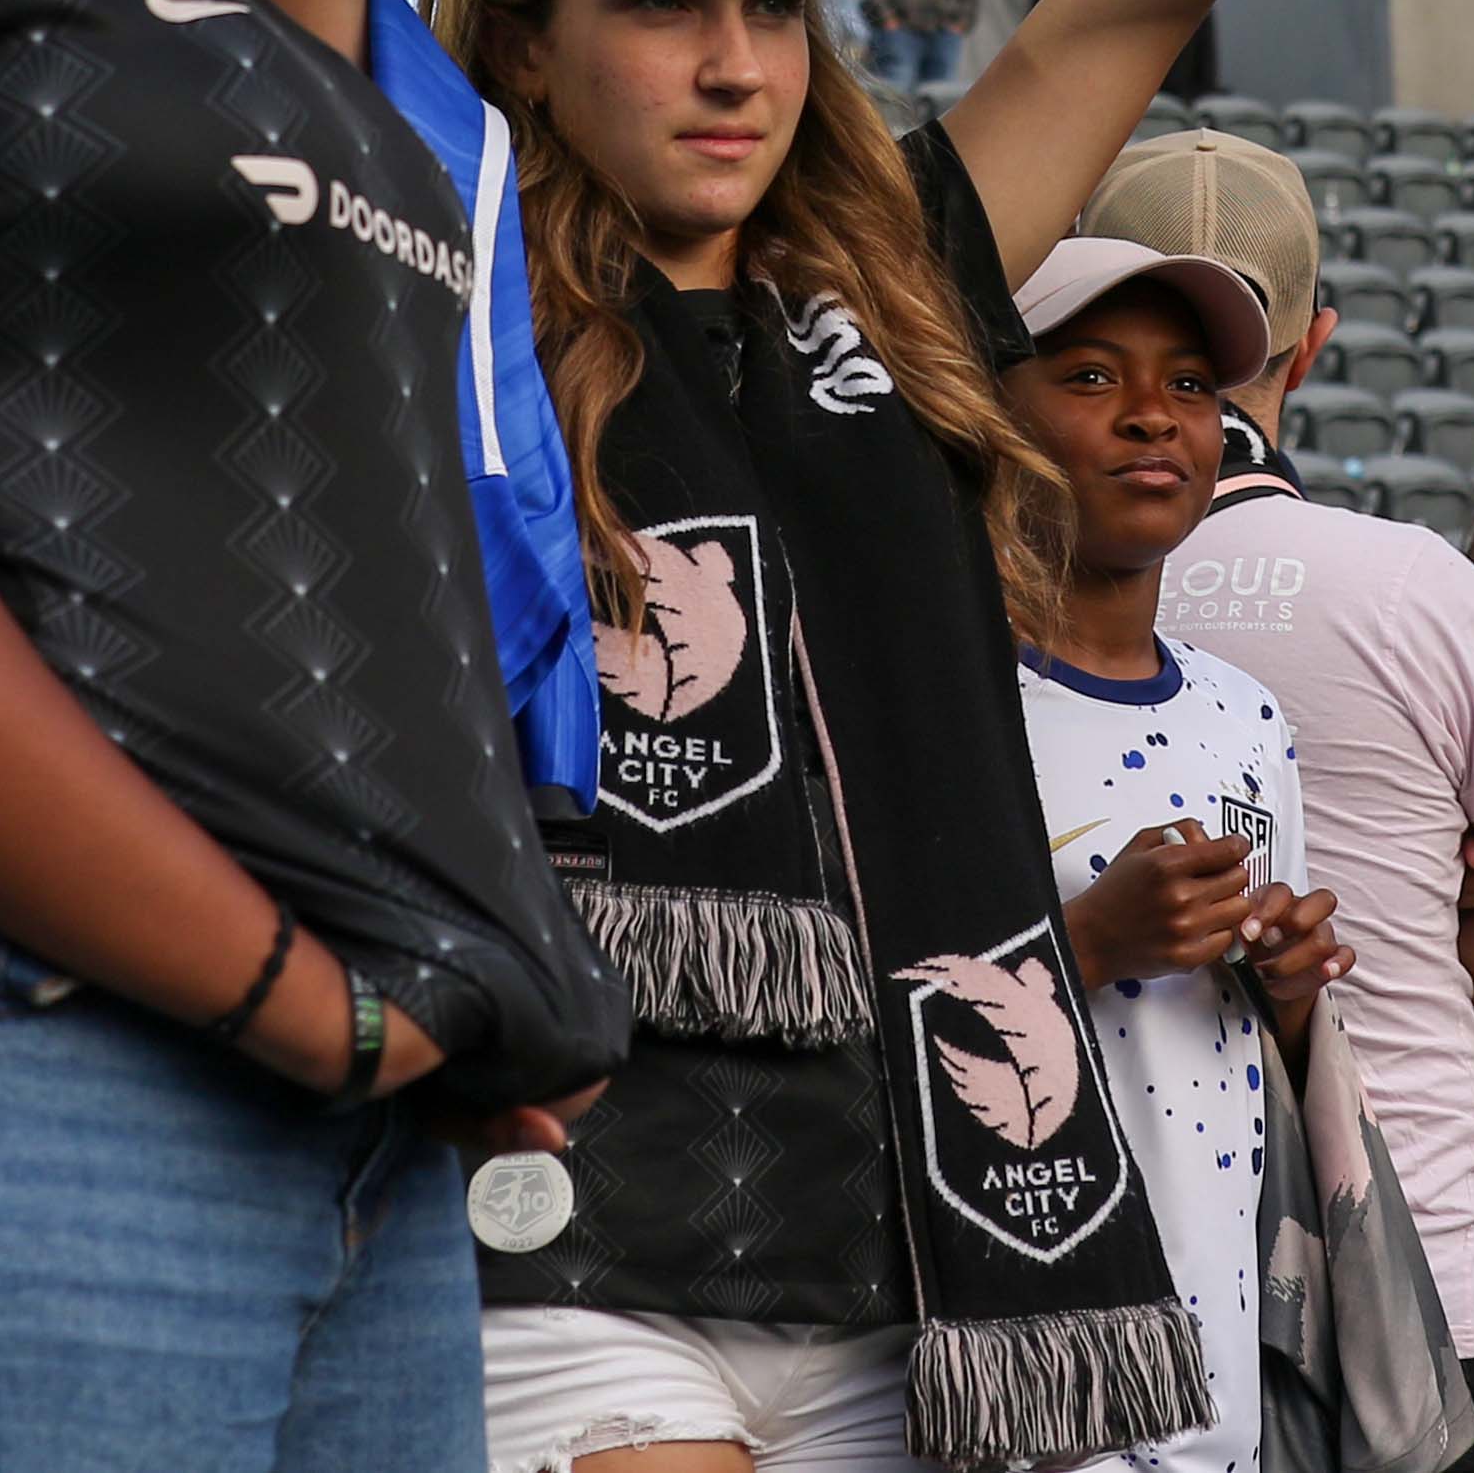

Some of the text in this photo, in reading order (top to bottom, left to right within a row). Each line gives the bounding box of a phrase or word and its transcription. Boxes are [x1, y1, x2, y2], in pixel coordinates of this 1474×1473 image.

[1156, 600, 1294, 622] SPORTS
[600, 730, 733, 765] ANGEL
[618, 758, 708, 789] CITY
[649, 788, 679, 807] FC
[1227, 805, 1267, 850] USA
[983, 1157, 1097, 1191] ANGEL
[521, 1191, 550, 1212] 10
[1005, 1186, 1079, 1217] CITY
[1031, 1217, 1059, 1237] FC
